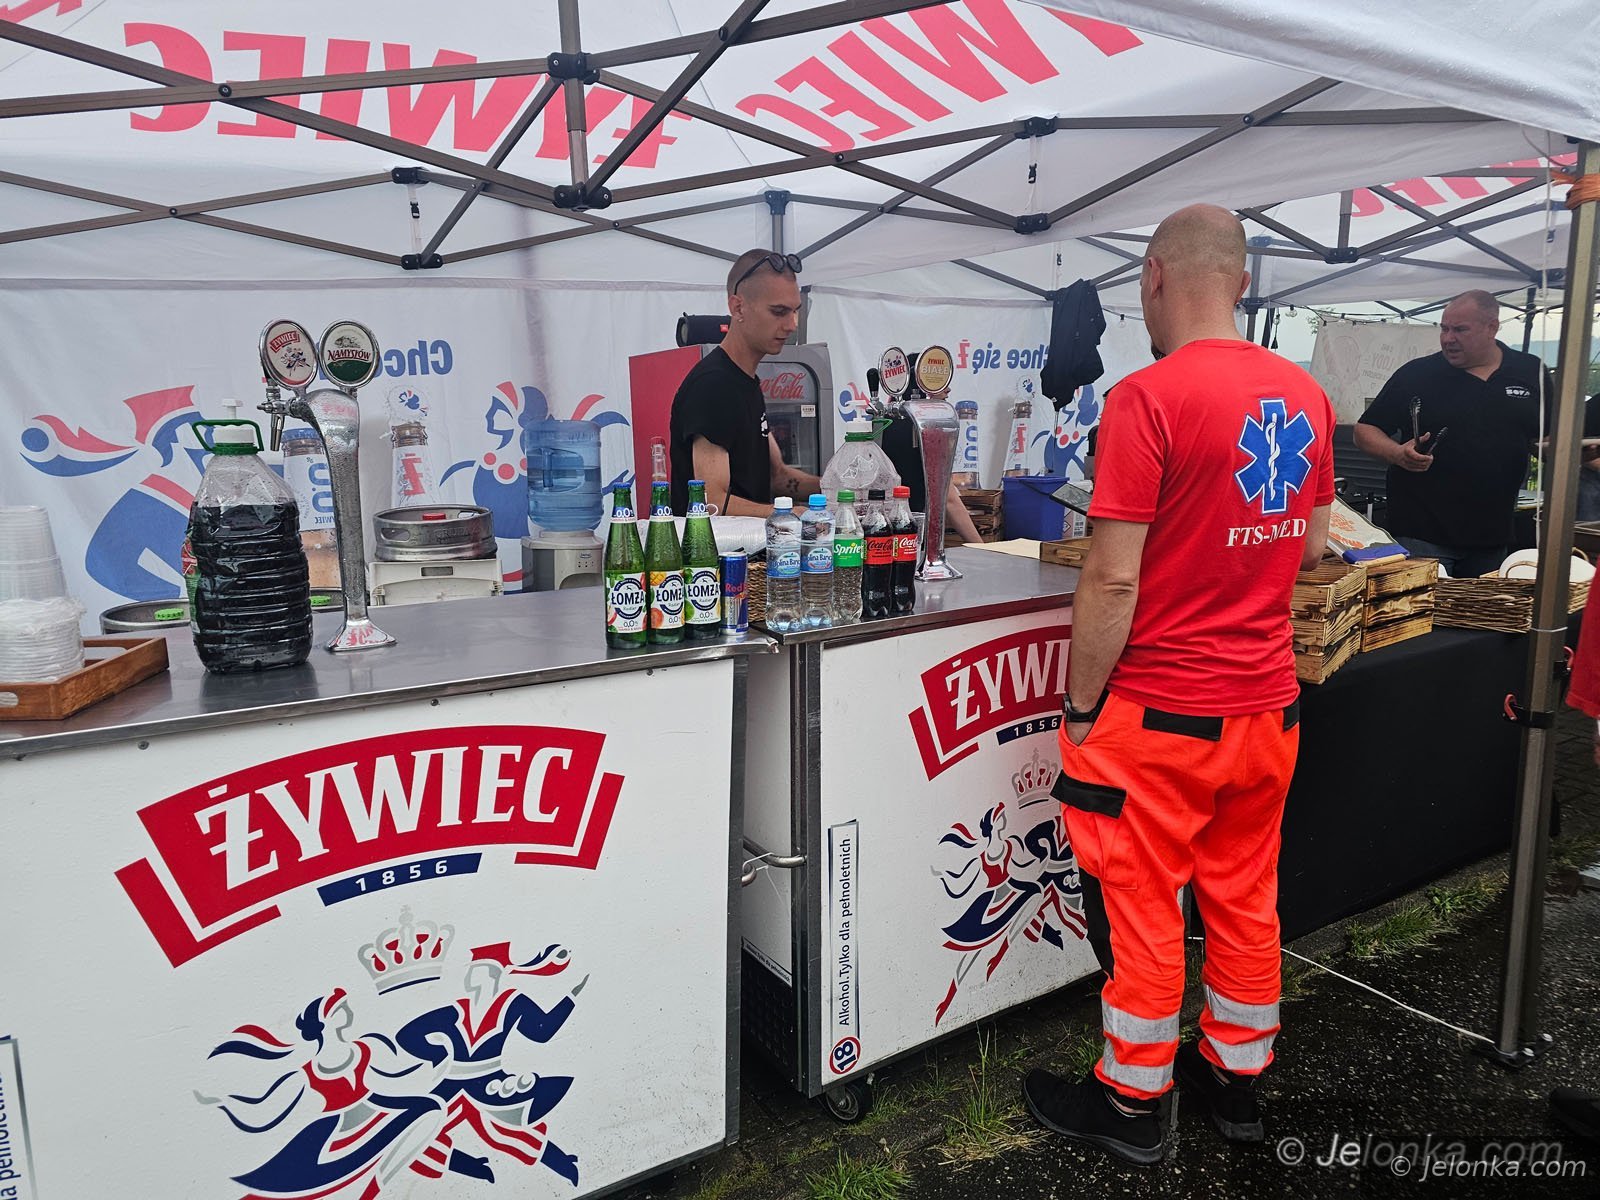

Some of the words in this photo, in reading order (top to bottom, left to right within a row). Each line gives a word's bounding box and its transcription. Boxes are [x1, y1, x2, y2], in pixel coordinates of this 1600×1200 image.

[1225, 518, 1307, 547] FTS-MED
[834, 543, 863, 556] Sprite
[945, 638, 1073, 731] ŻYWI
[193, 745, 573, 891] ŻYWIEC
[354, 859, 449, 893] 1856
[838, 838, 853, 918] pełnoletnich
[838, 920, 850, 941] dla
[833, 1040, 857, 1072] 18
